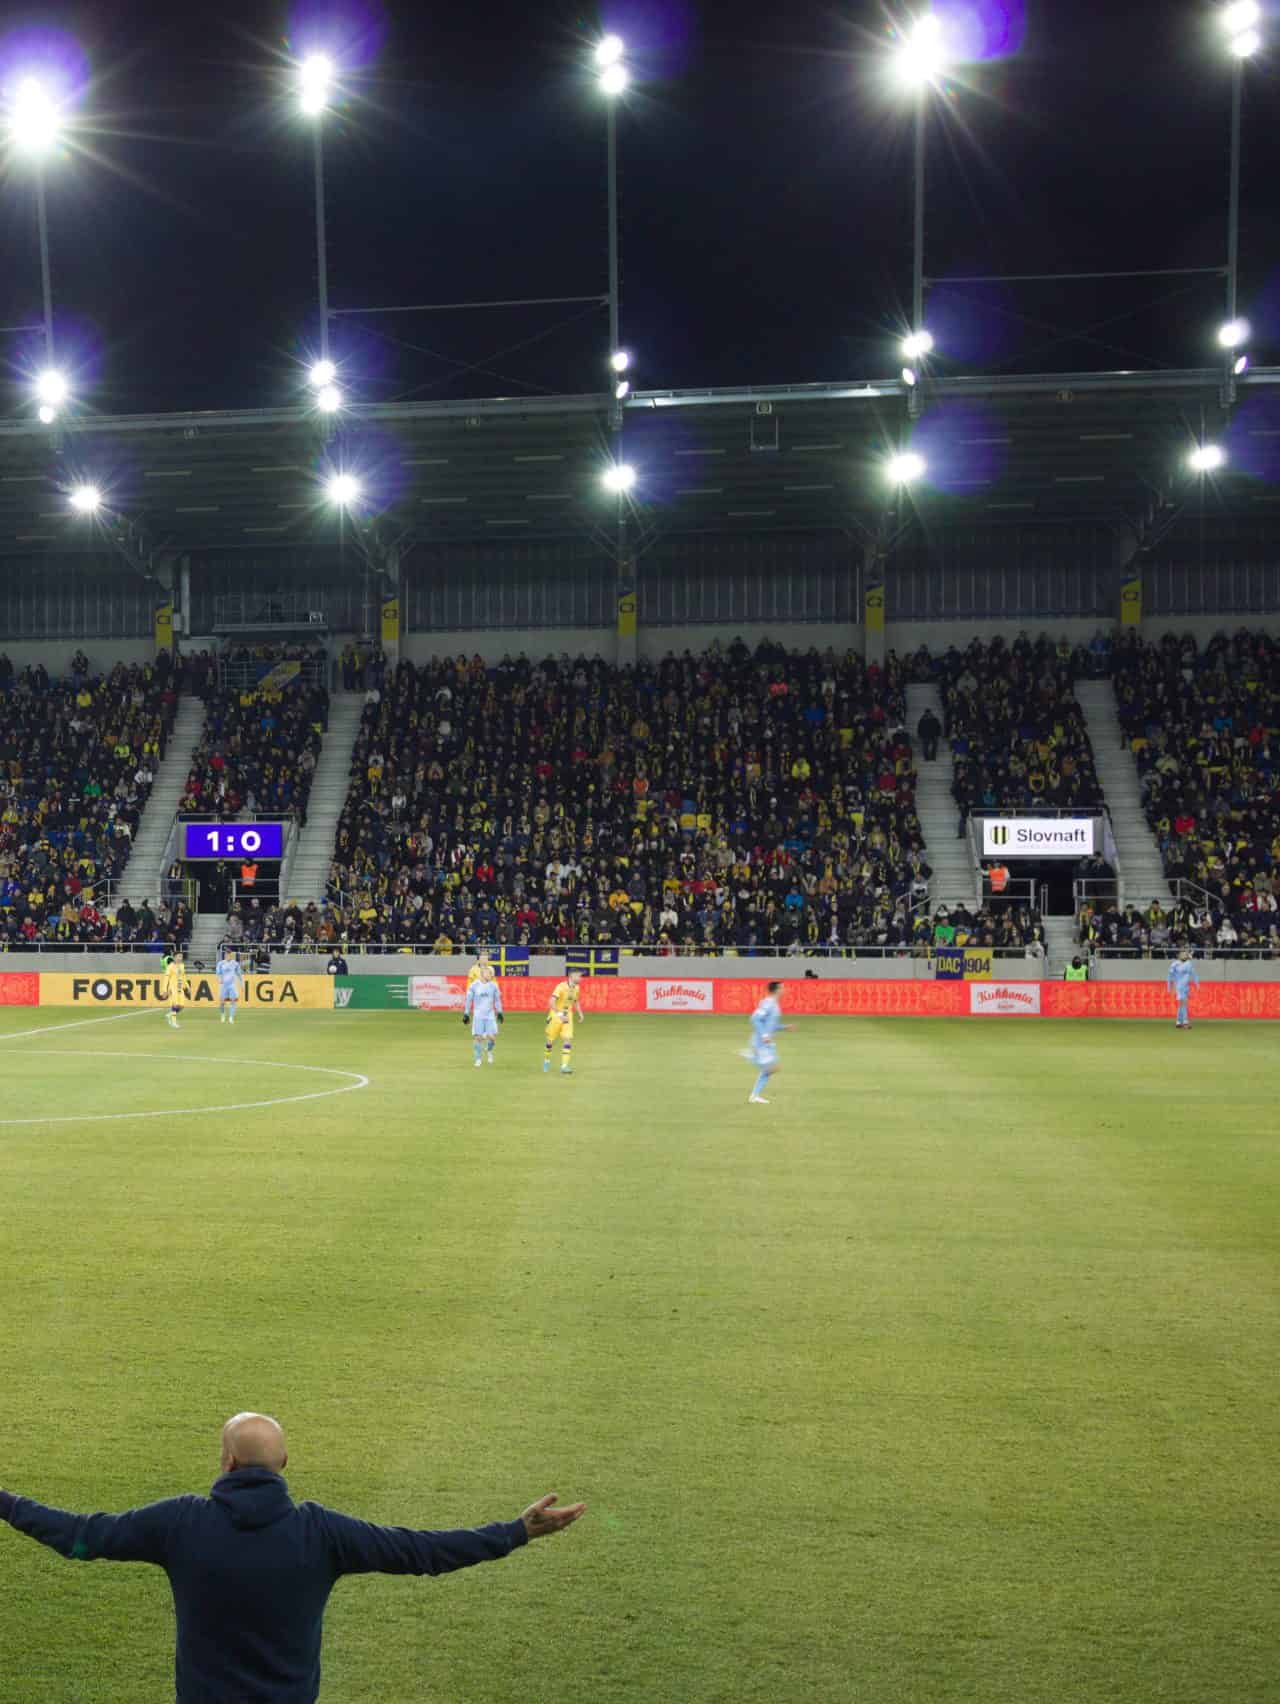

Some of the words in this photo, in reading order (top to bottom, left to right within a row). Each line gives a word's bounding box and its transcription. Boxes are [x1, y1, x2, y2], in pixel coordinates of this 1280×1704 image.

[207, 830, 261, 852] 1:0
[1017, 828, 1087, 842] Slovnaft
[938, 957, 960, 973] DAC
[242, 979, 298, 1002] IGA
[977, 987, 1033, 1005] Kukkonia
